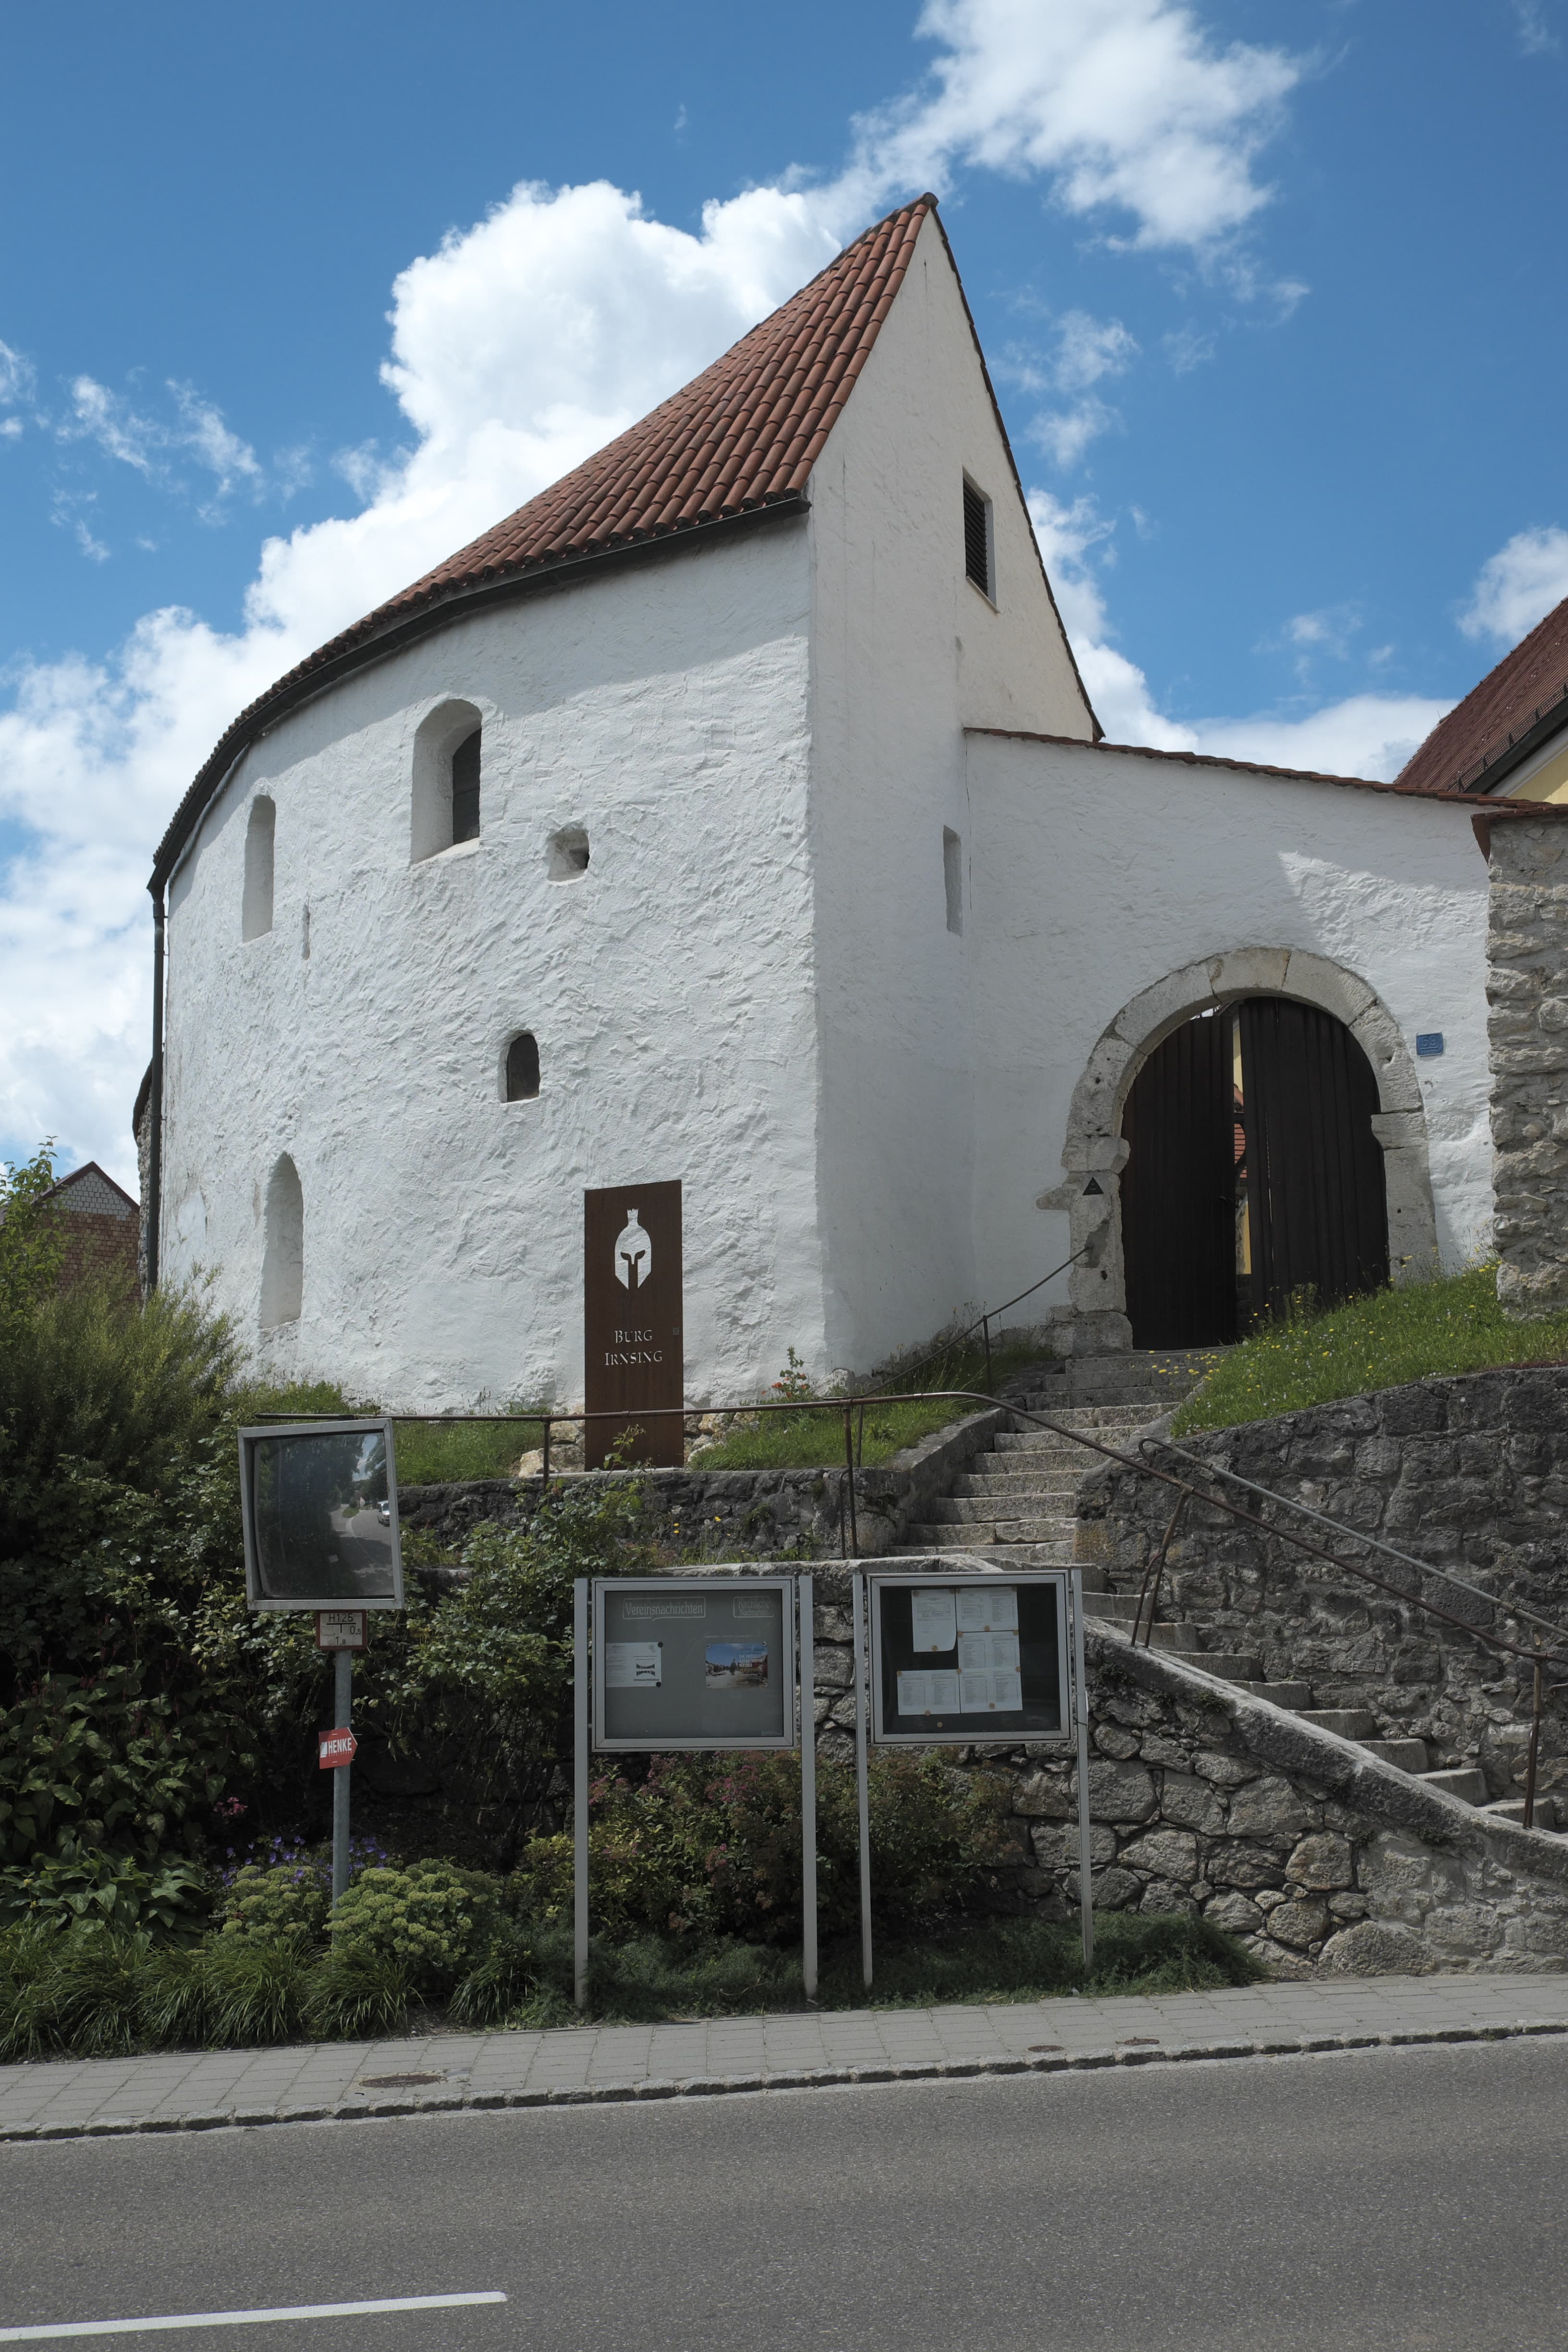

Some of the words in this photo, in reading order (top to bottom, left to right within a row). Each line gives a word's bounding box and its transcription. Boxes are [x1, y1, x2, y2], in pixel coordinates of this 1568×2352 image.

[614, 1330, 653, 1344] BURG
[604, 1350, 662, 1366] IRNSING
[625, 1601, 703, 1616] Vereinsnachrichten
[738, 1598, 769, 1608] Kirchliche
[329, 1613, 353, 1622] H125
[328, 1737, 352, 1754] HENKE
